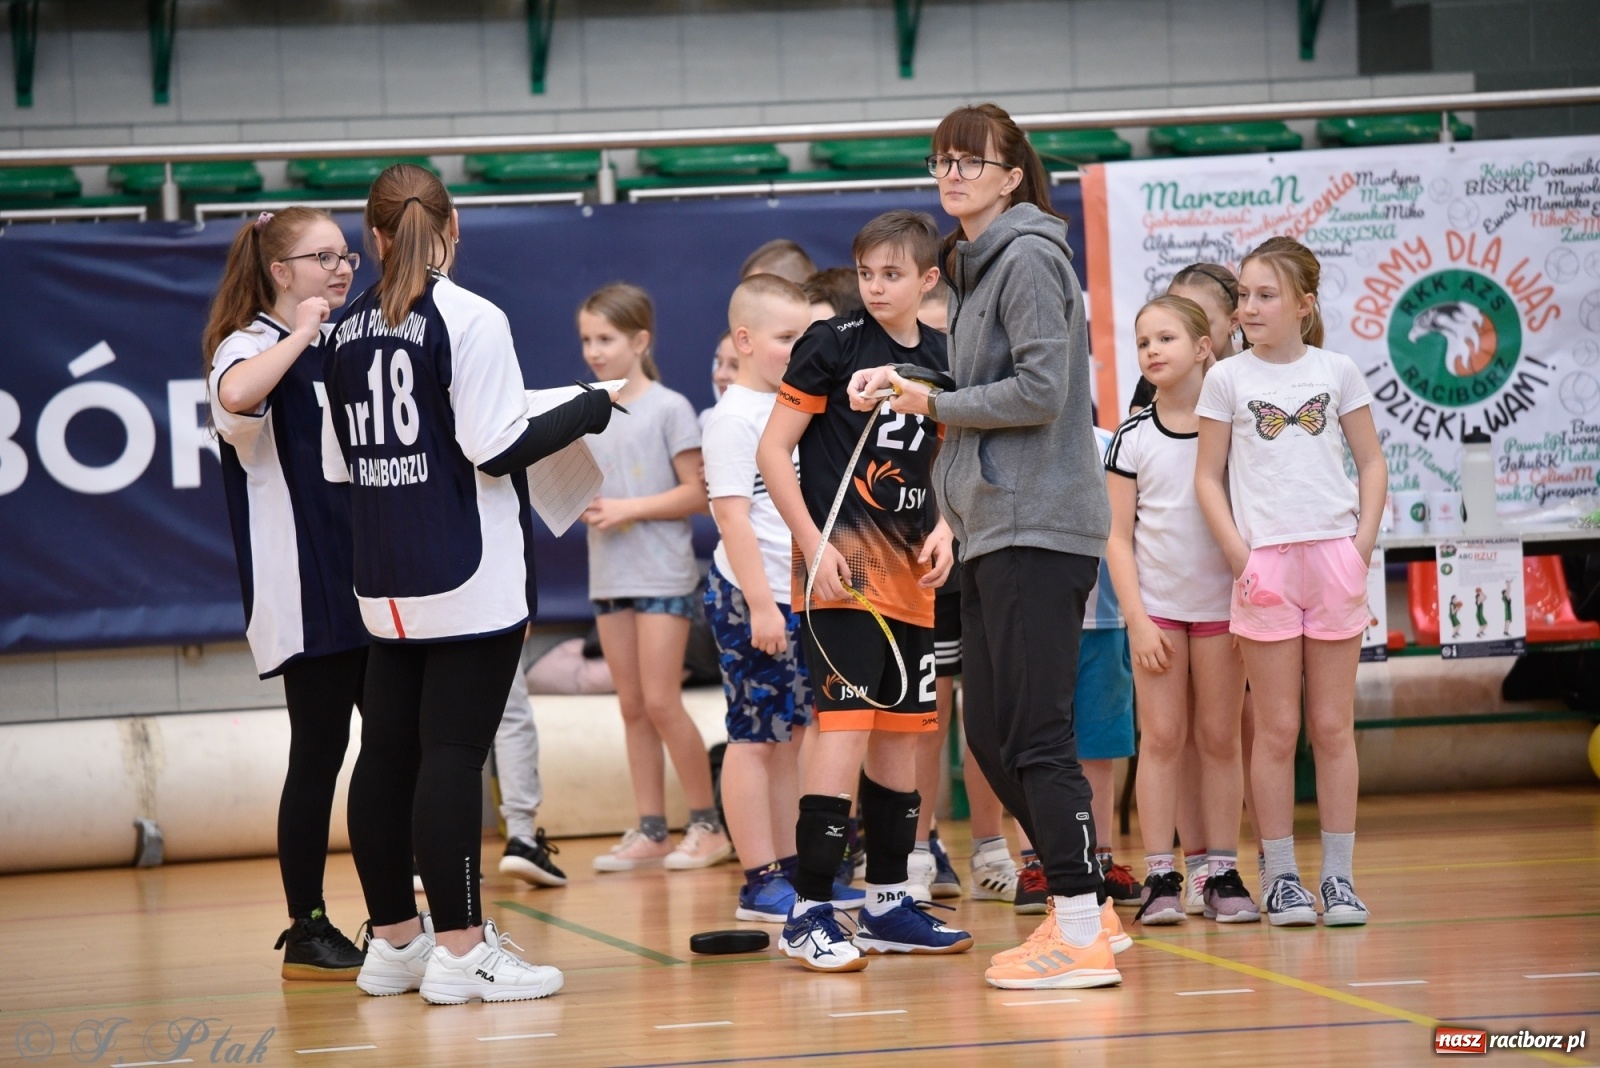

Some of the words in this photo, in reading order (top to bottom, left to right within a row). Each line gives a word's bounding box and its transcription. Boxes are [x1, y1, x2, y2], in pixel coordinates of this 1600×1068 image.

[1537, 157, 1600, 178] Dominik
[1350, 236, 1432, 340] GRAMY
[1445, 229, 1502, 274] DLA
[1505, 256, 1561, 333] WAS
[1401, 274, 1448, 316] RKK
[1460, 276, 1506, 312] AZS
[1402, 356, 1512, 404] RACIBÓRZ
[475, 968, 495, 983] FILA
